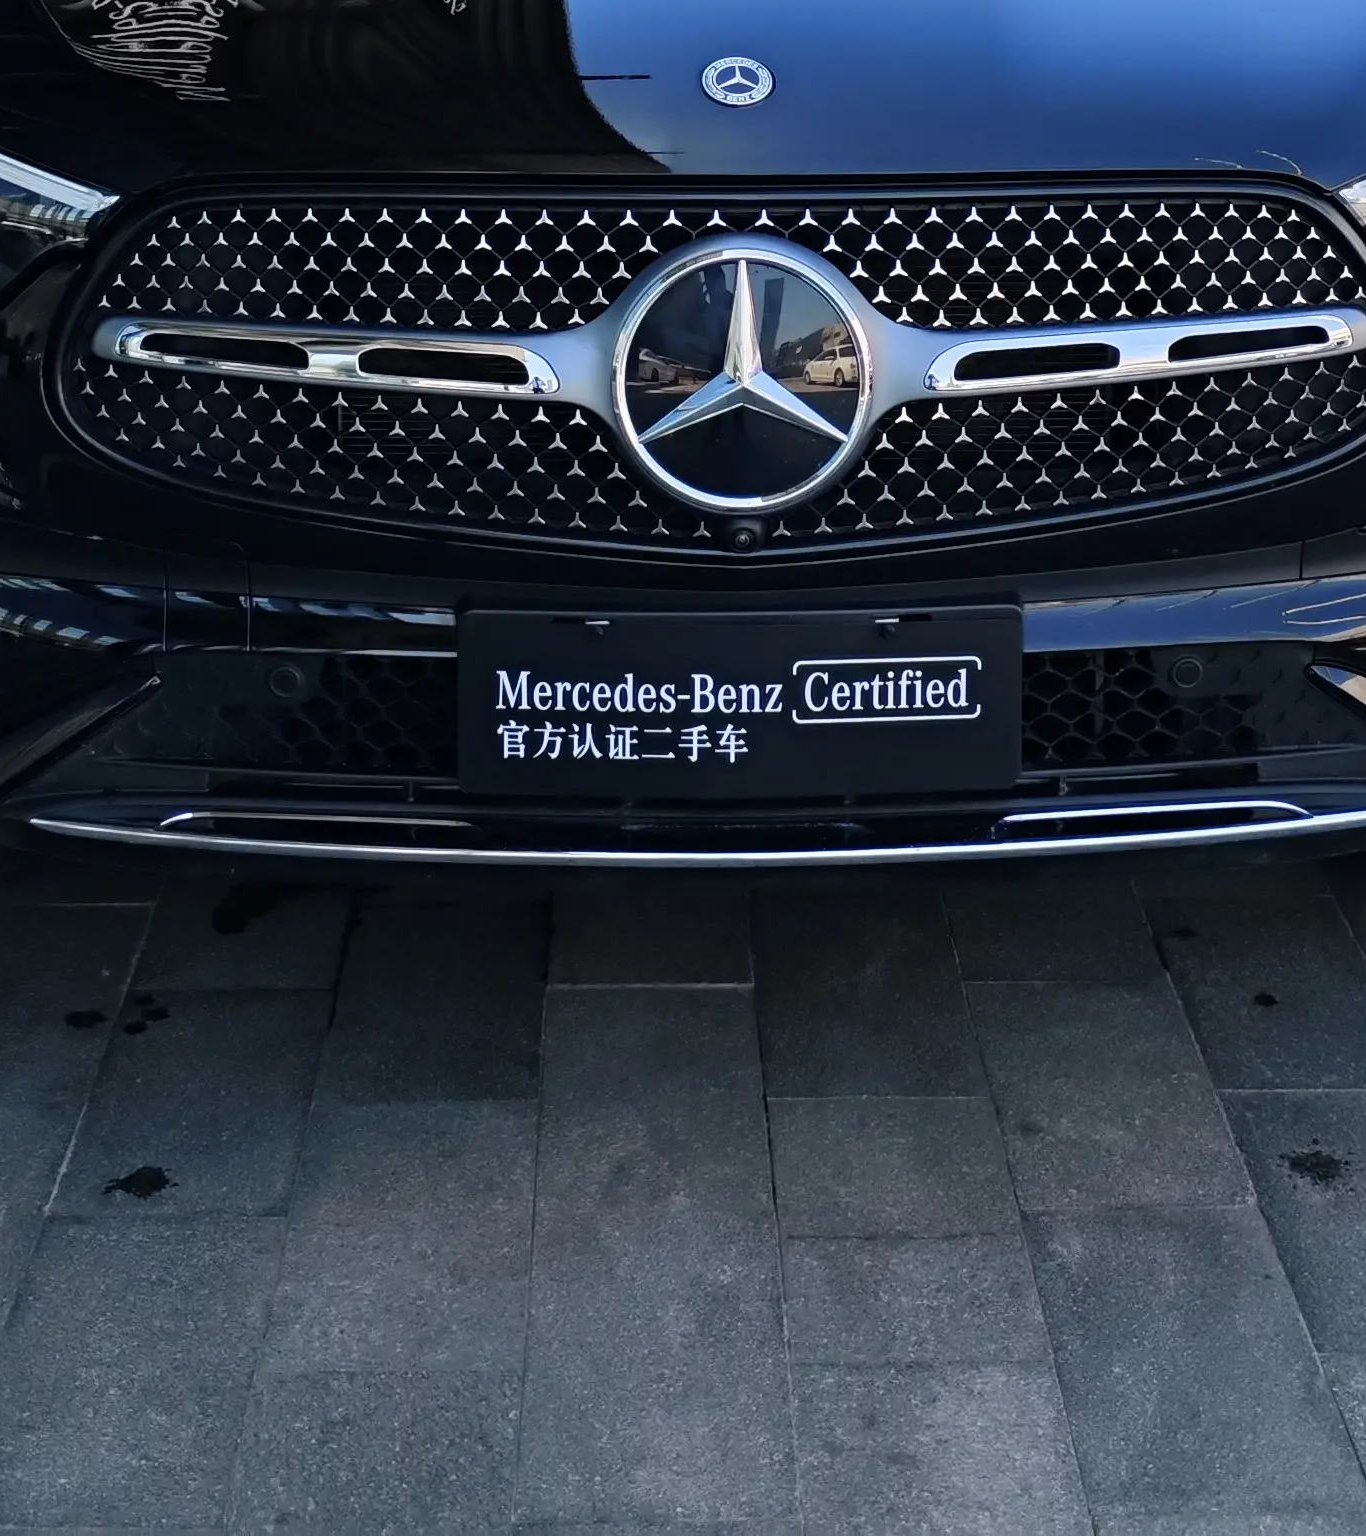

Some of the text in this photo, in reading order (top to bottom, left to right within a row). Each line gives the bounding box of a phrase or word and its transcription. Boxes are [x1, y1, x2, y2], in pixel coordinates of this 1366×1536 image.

[495, 668, 970, 714] Mercedes-Benz Certified
[496, 720, 750, 764] 官方认证二手车
